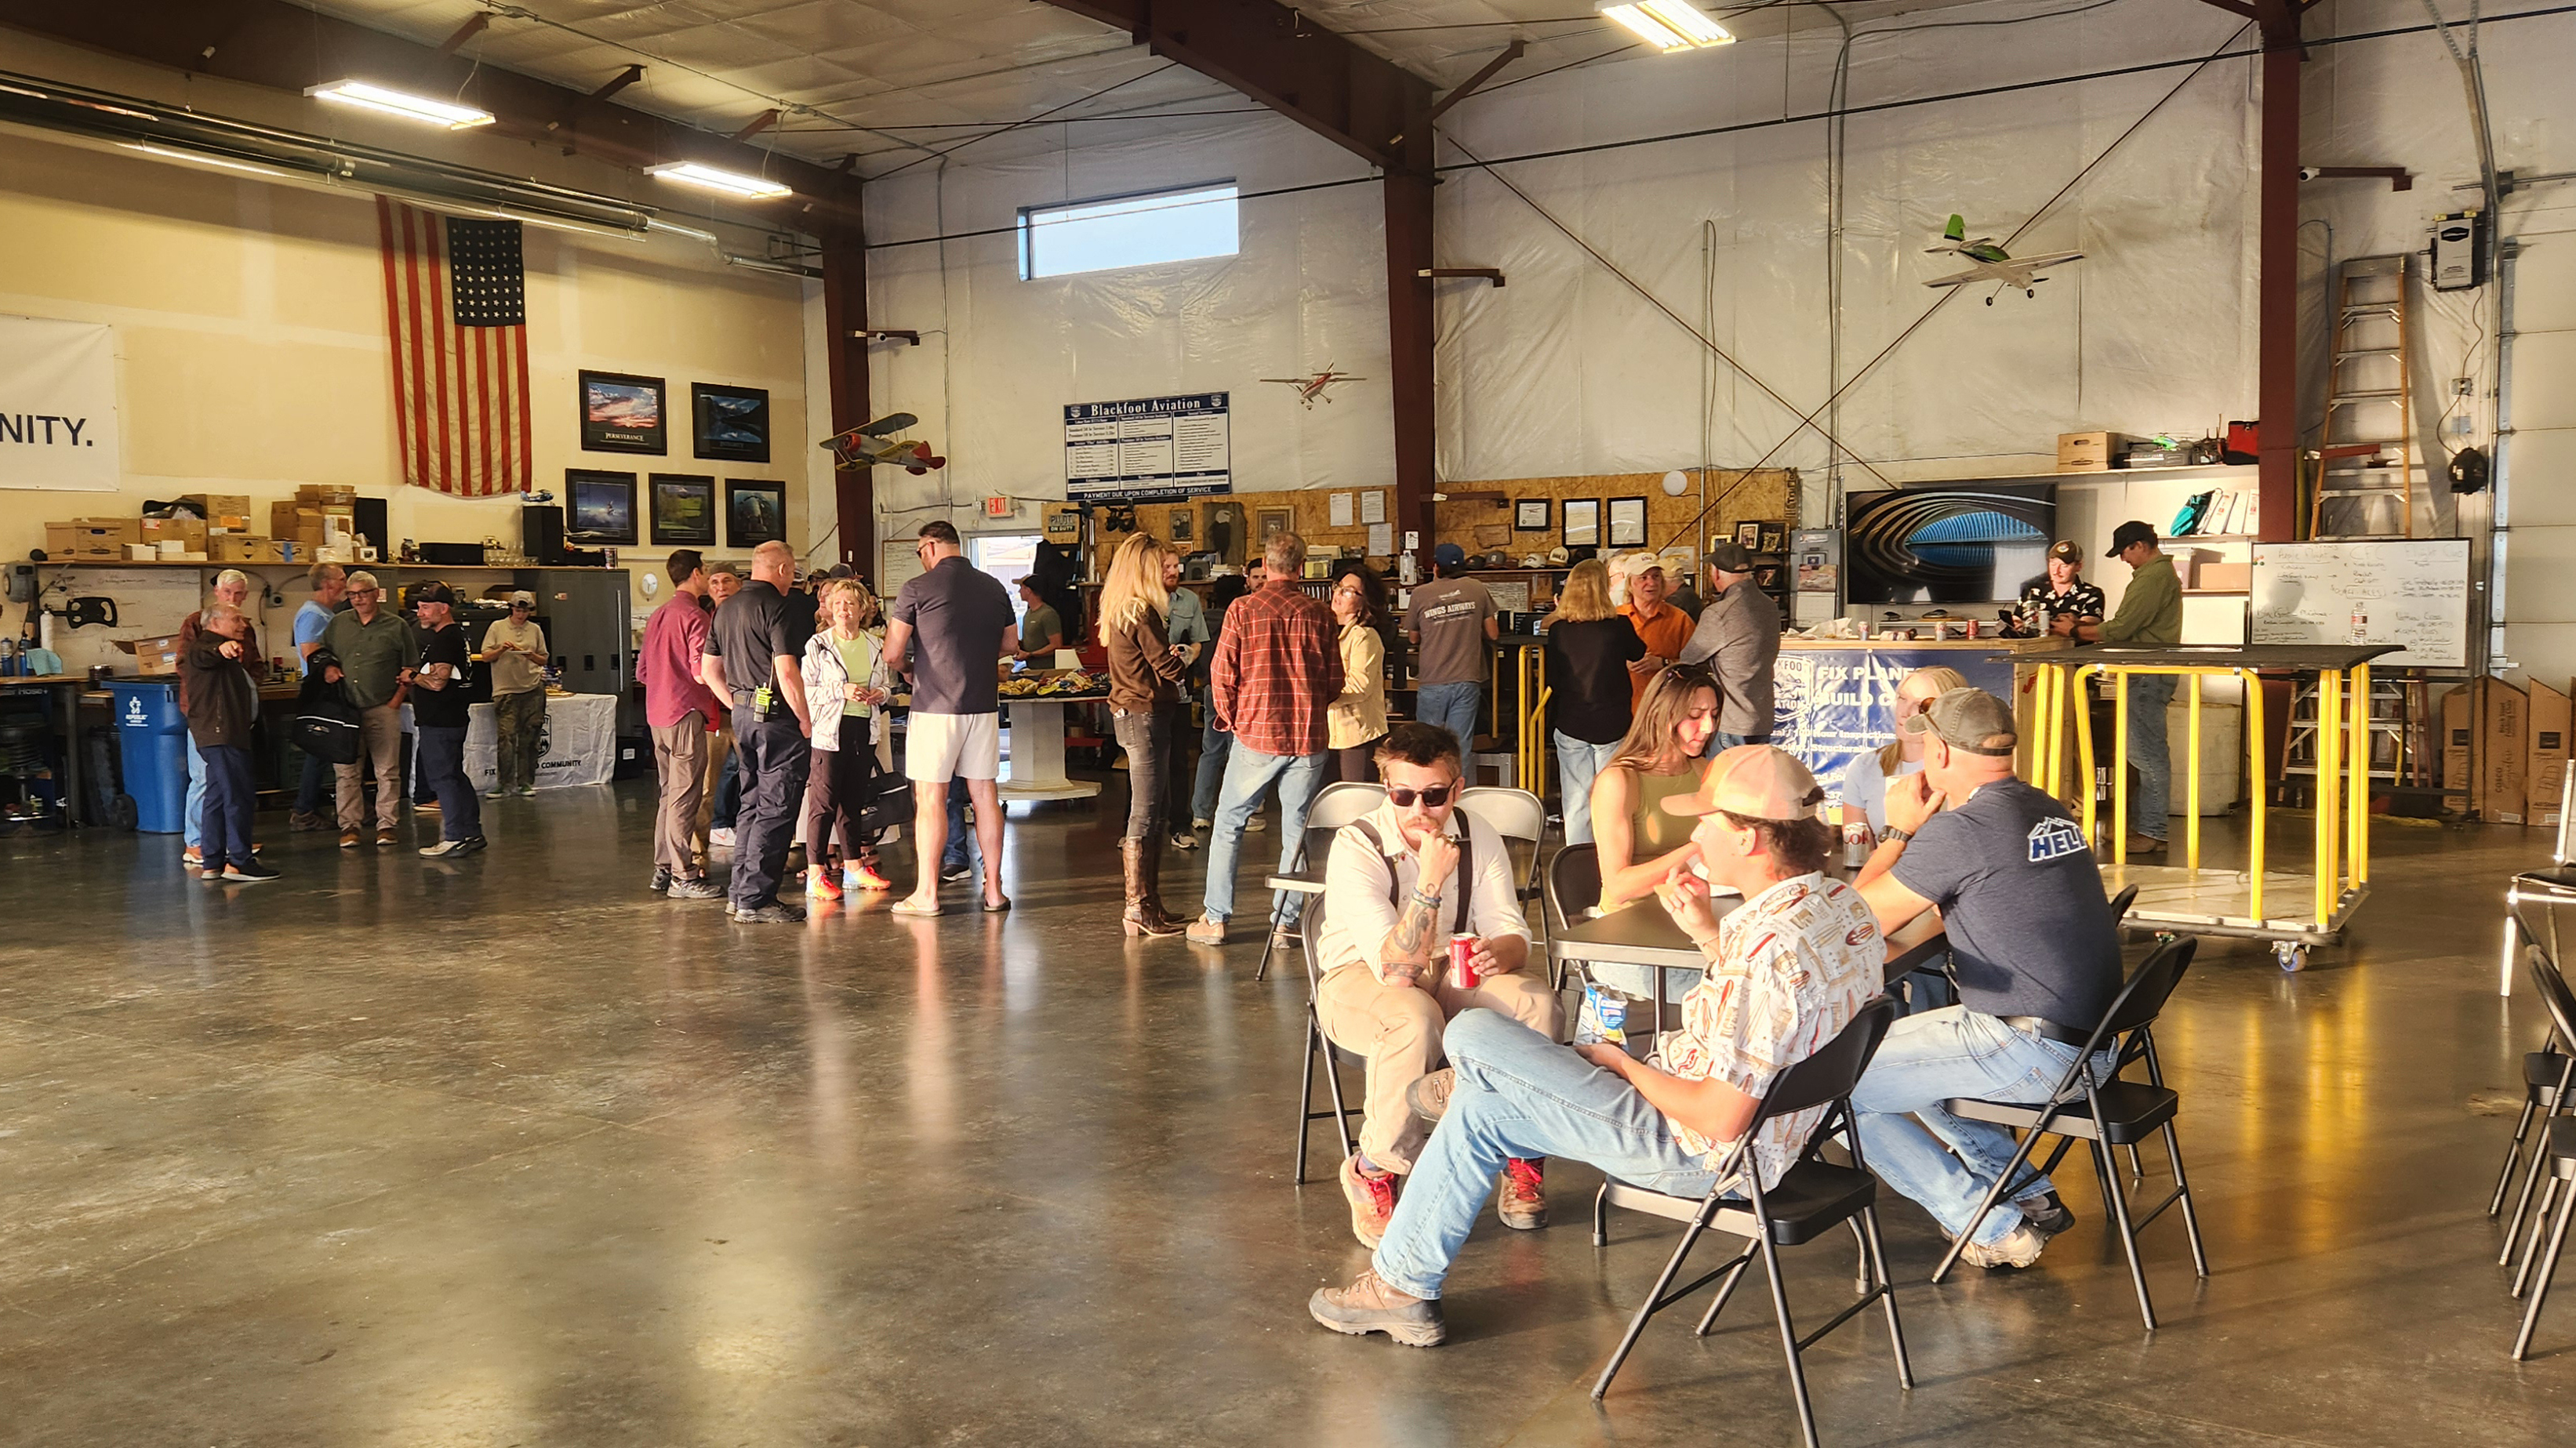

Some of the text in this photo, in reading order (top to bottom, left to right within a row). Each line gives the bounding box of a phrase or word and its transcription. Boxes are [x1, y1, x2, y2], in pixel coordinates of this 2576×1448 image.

[1091, 398, 1201, 417] Blackfoot Aviation
[0, 412, 93, 447] NITY.
[605, 432, 644, 441] PERSEVERANCE
[1140, 488, 1176, 496] COMPLETION
[989, 497, 1006, 514] EXIT
[1424, 606, 1446, 619] WINGS
[1447, 601, 1476, 613] AIRWAYS
[1818, 666, 1848, 680] FIX
[542, 760, 582, 769] COMMUNITY
